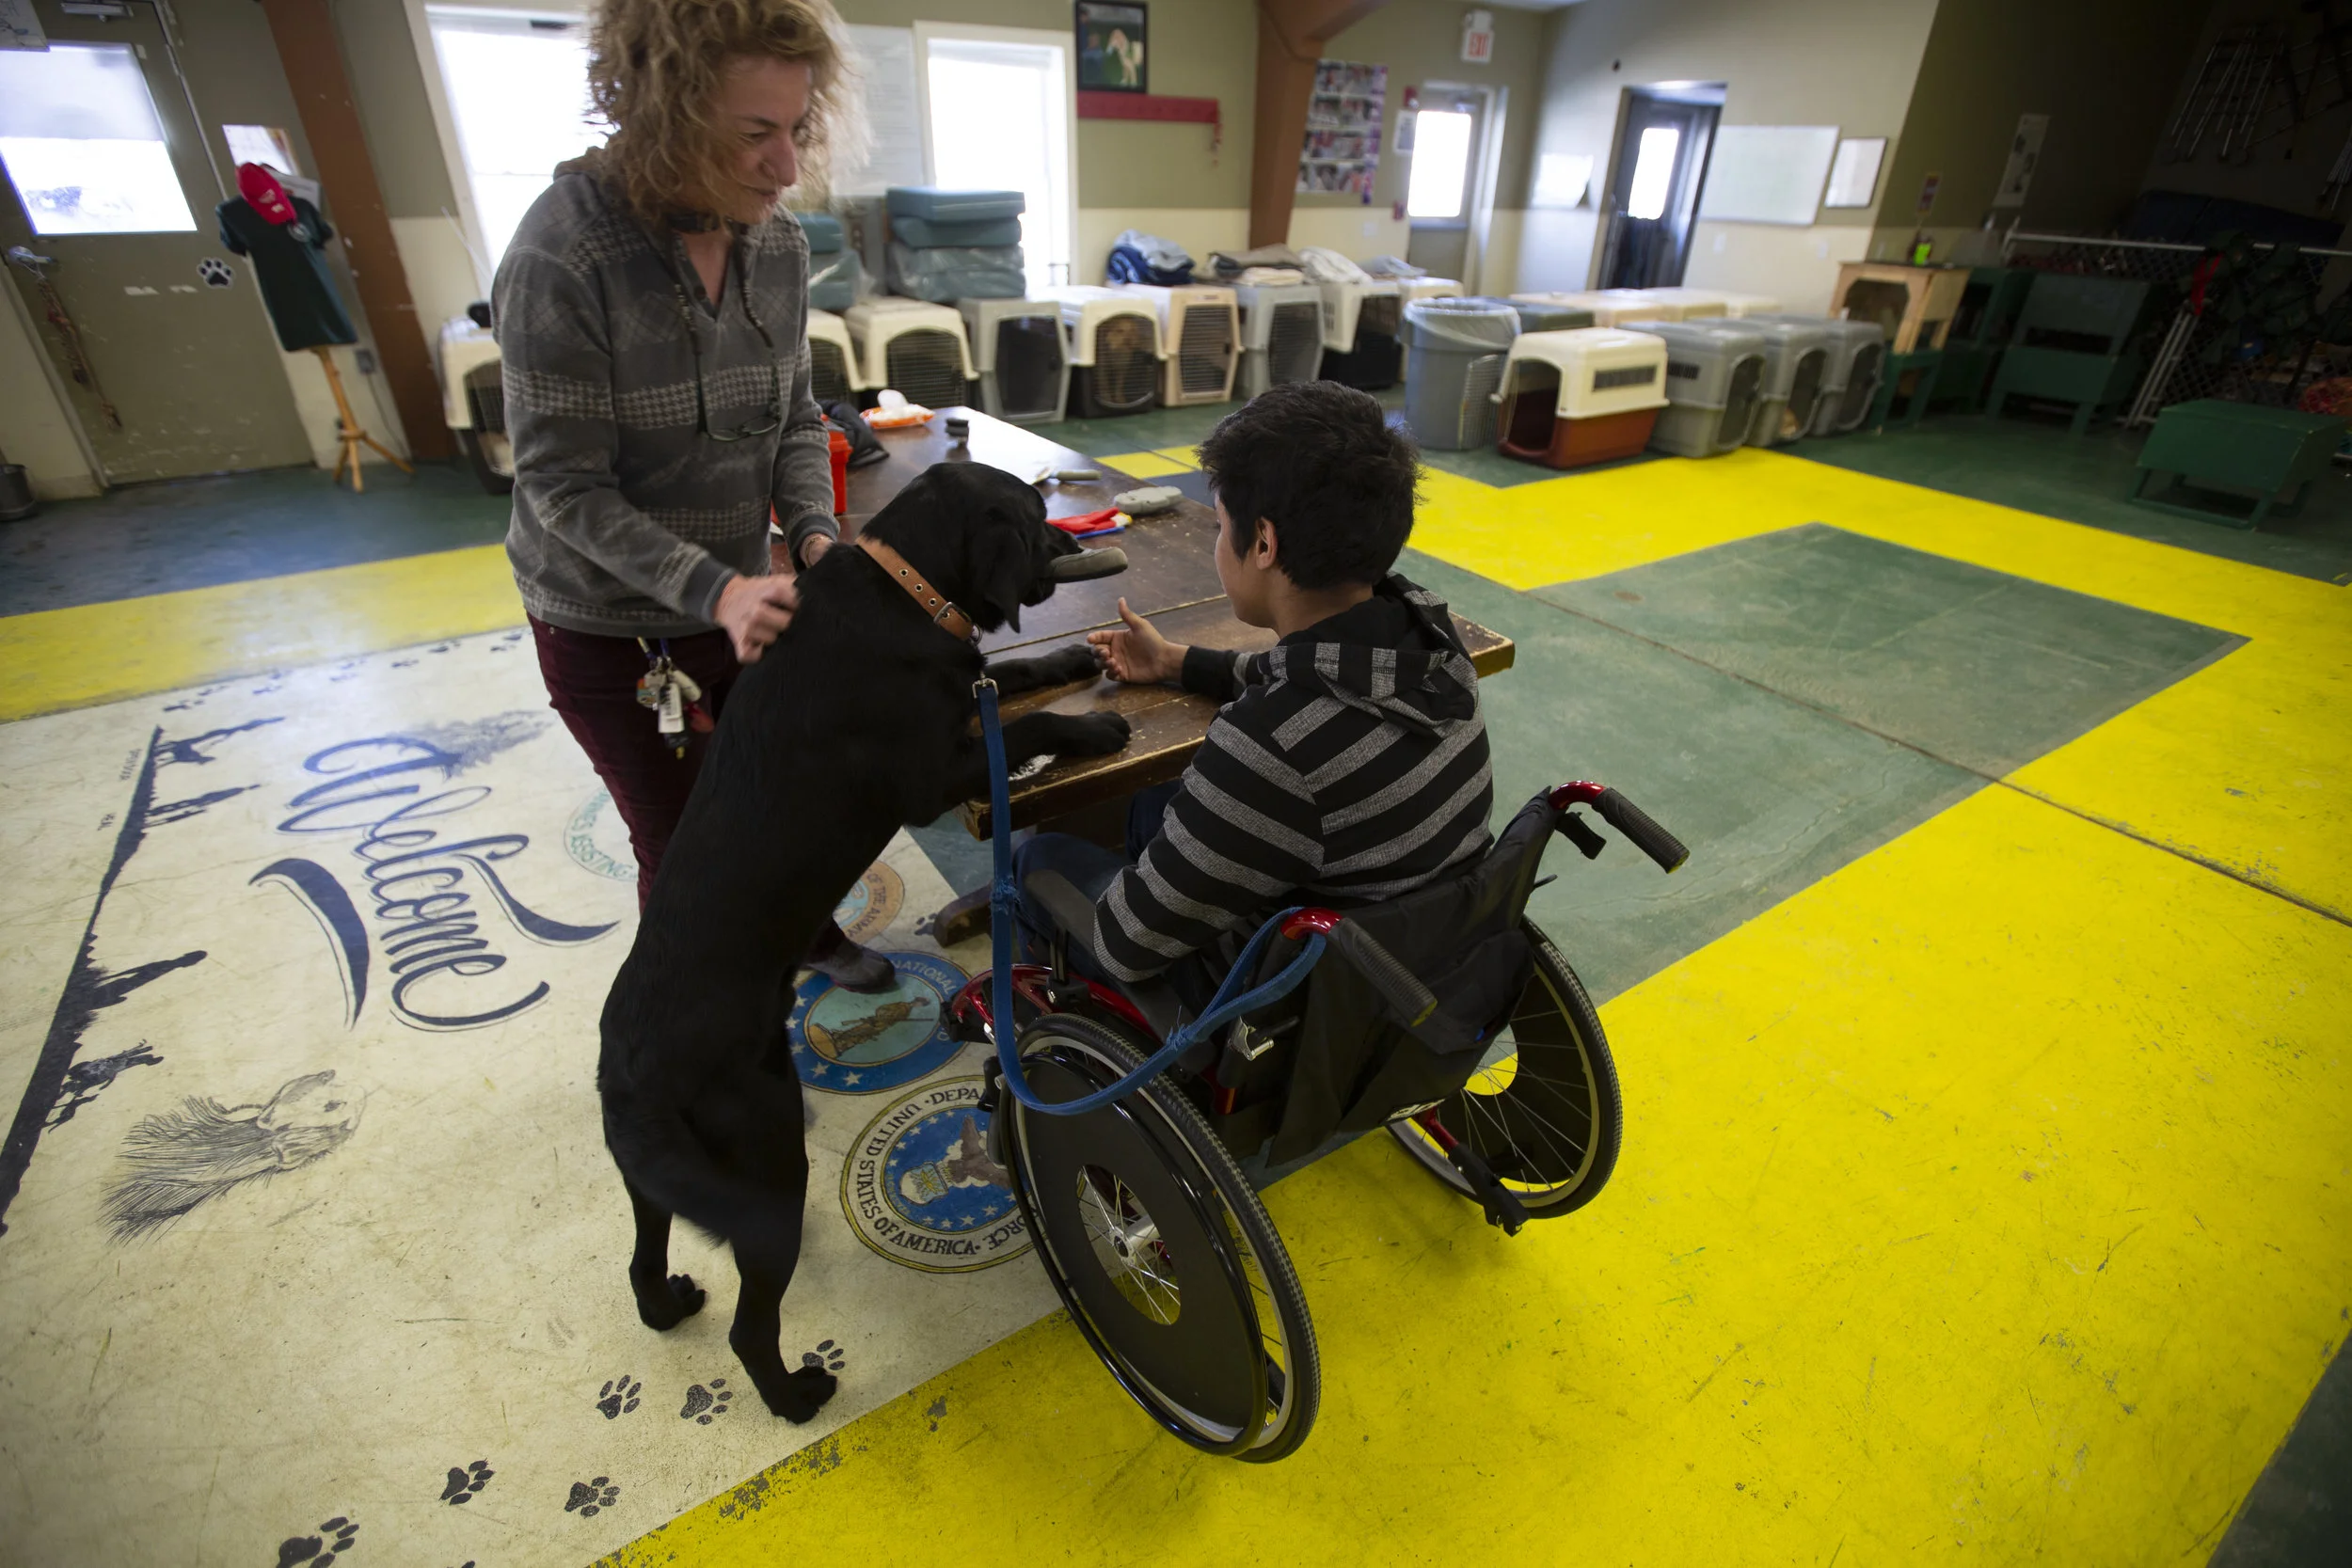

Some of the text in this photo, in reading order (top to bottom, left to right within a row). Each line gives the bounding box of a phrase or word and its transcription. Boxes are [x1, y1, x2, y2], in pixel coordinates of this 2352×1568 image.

[277, 736, 550, 1033] Welcome
[847, 872, 887, 938] OF THE ARMY
[890, 958, 958, 995] NATIONAL
[930, 1087, 987, 1106] DEPA
[857, 1101, 977, 1256] UNITED STATES OF AMERICA
[987, 1213, 1028, 1251] ORCE
